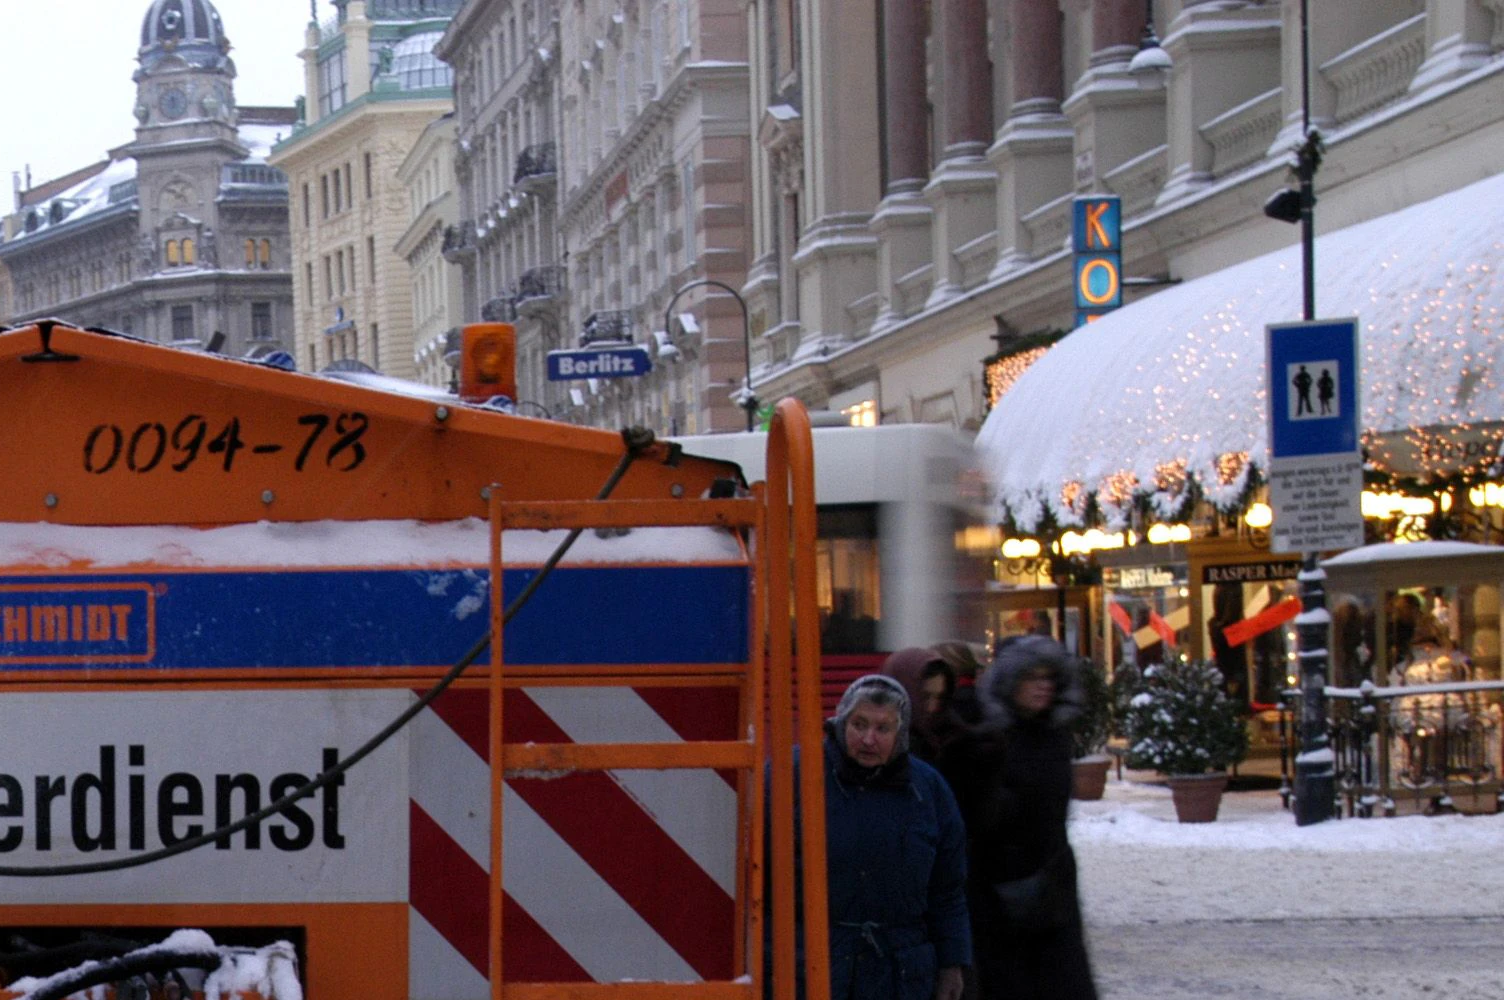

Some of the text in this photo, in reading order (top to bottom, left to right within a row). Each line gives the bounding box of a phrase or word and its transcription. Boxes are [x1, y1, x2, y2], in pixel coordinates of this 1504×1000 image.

[558, 354, 635, 375] Berlitz
[83, 411, 369, 475] 0094-78
[1209, 565, 1267, 581] RASPER
